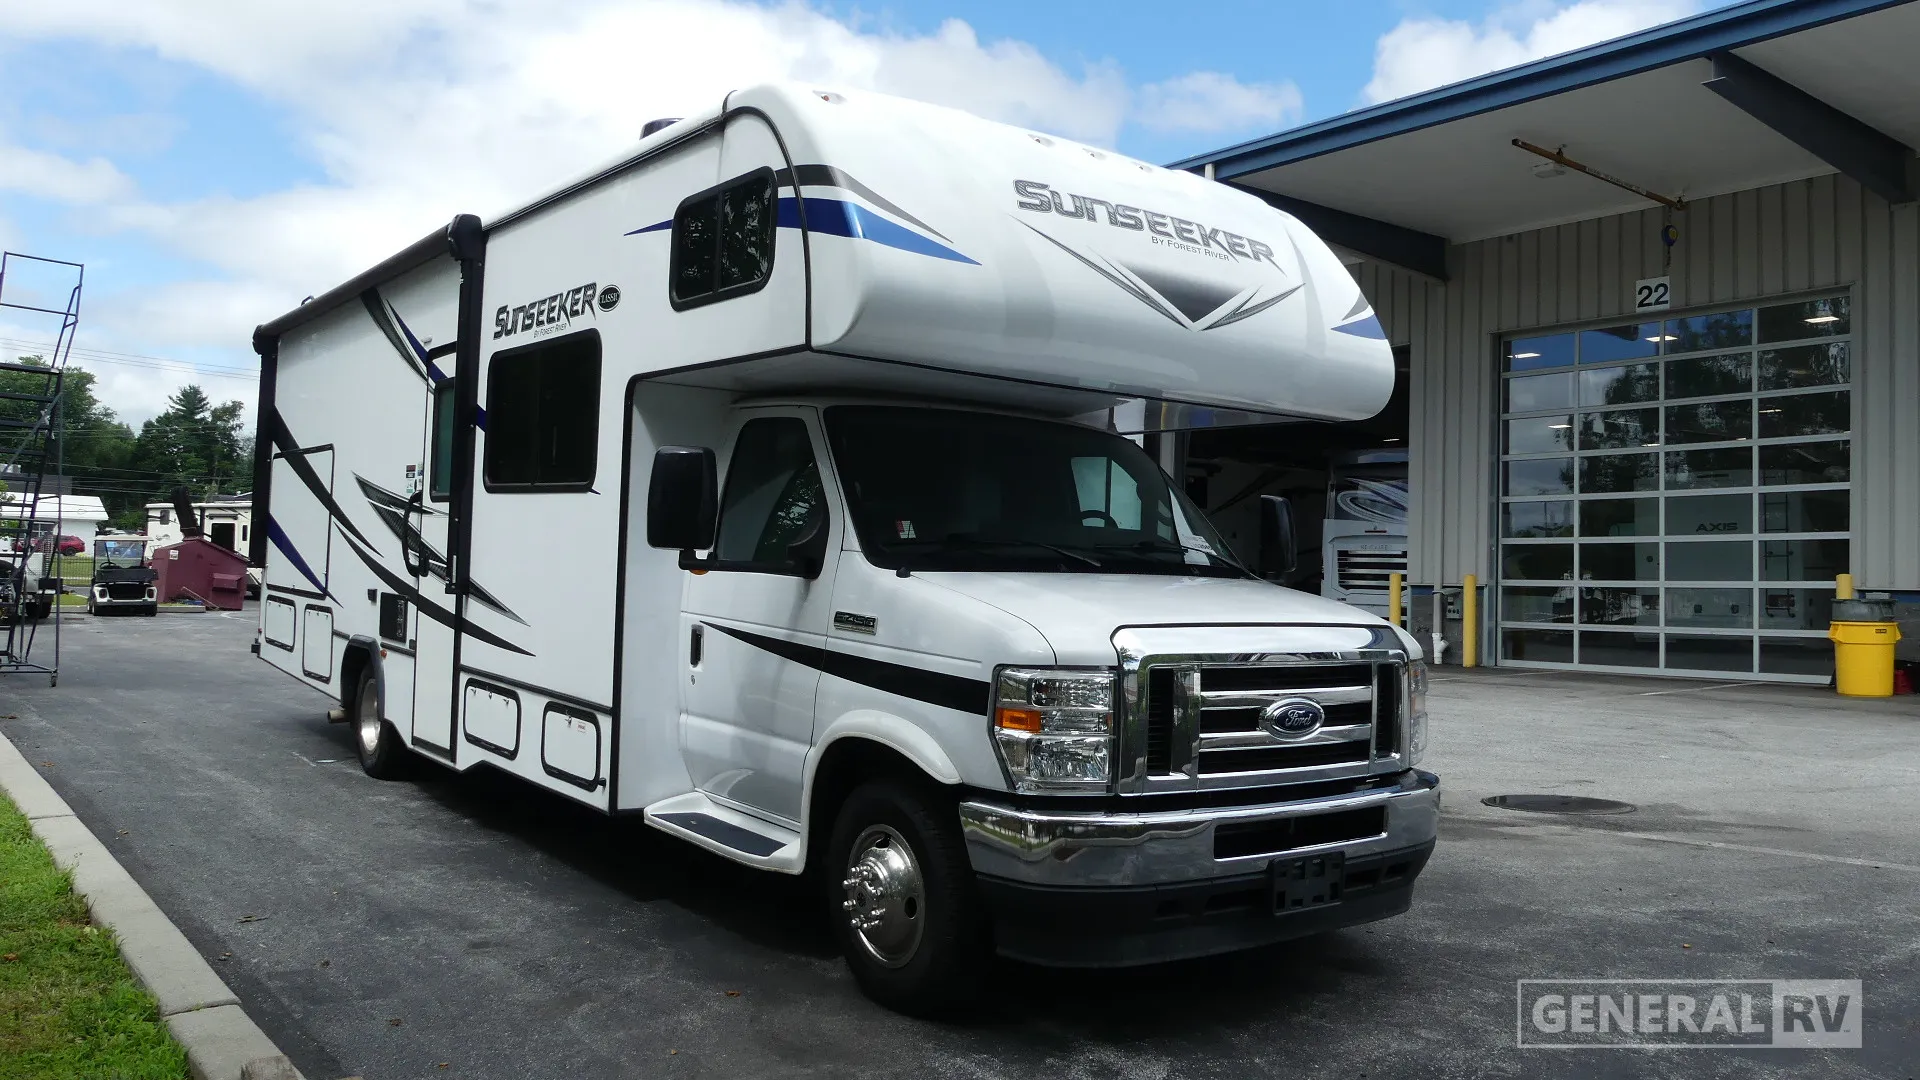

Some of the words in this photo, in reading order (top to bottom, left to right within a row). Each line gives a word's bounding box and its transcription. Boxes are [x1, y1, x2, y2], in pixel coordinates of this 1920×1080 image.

[1013, 179, 1287, 277] SUNSEEKER
[1151, 236, 1166, 246] BY
[1167, 239, 1203, 254] FOREST
[1204, 248, 1230, 262] RIVER
[1637, 283, 1669, 308] 22
[493, 282, 598, 341] SUNSEEKER
[1696, 522, 1738, 532] AXIS
[1285, 709, 1313, 726] Ford
